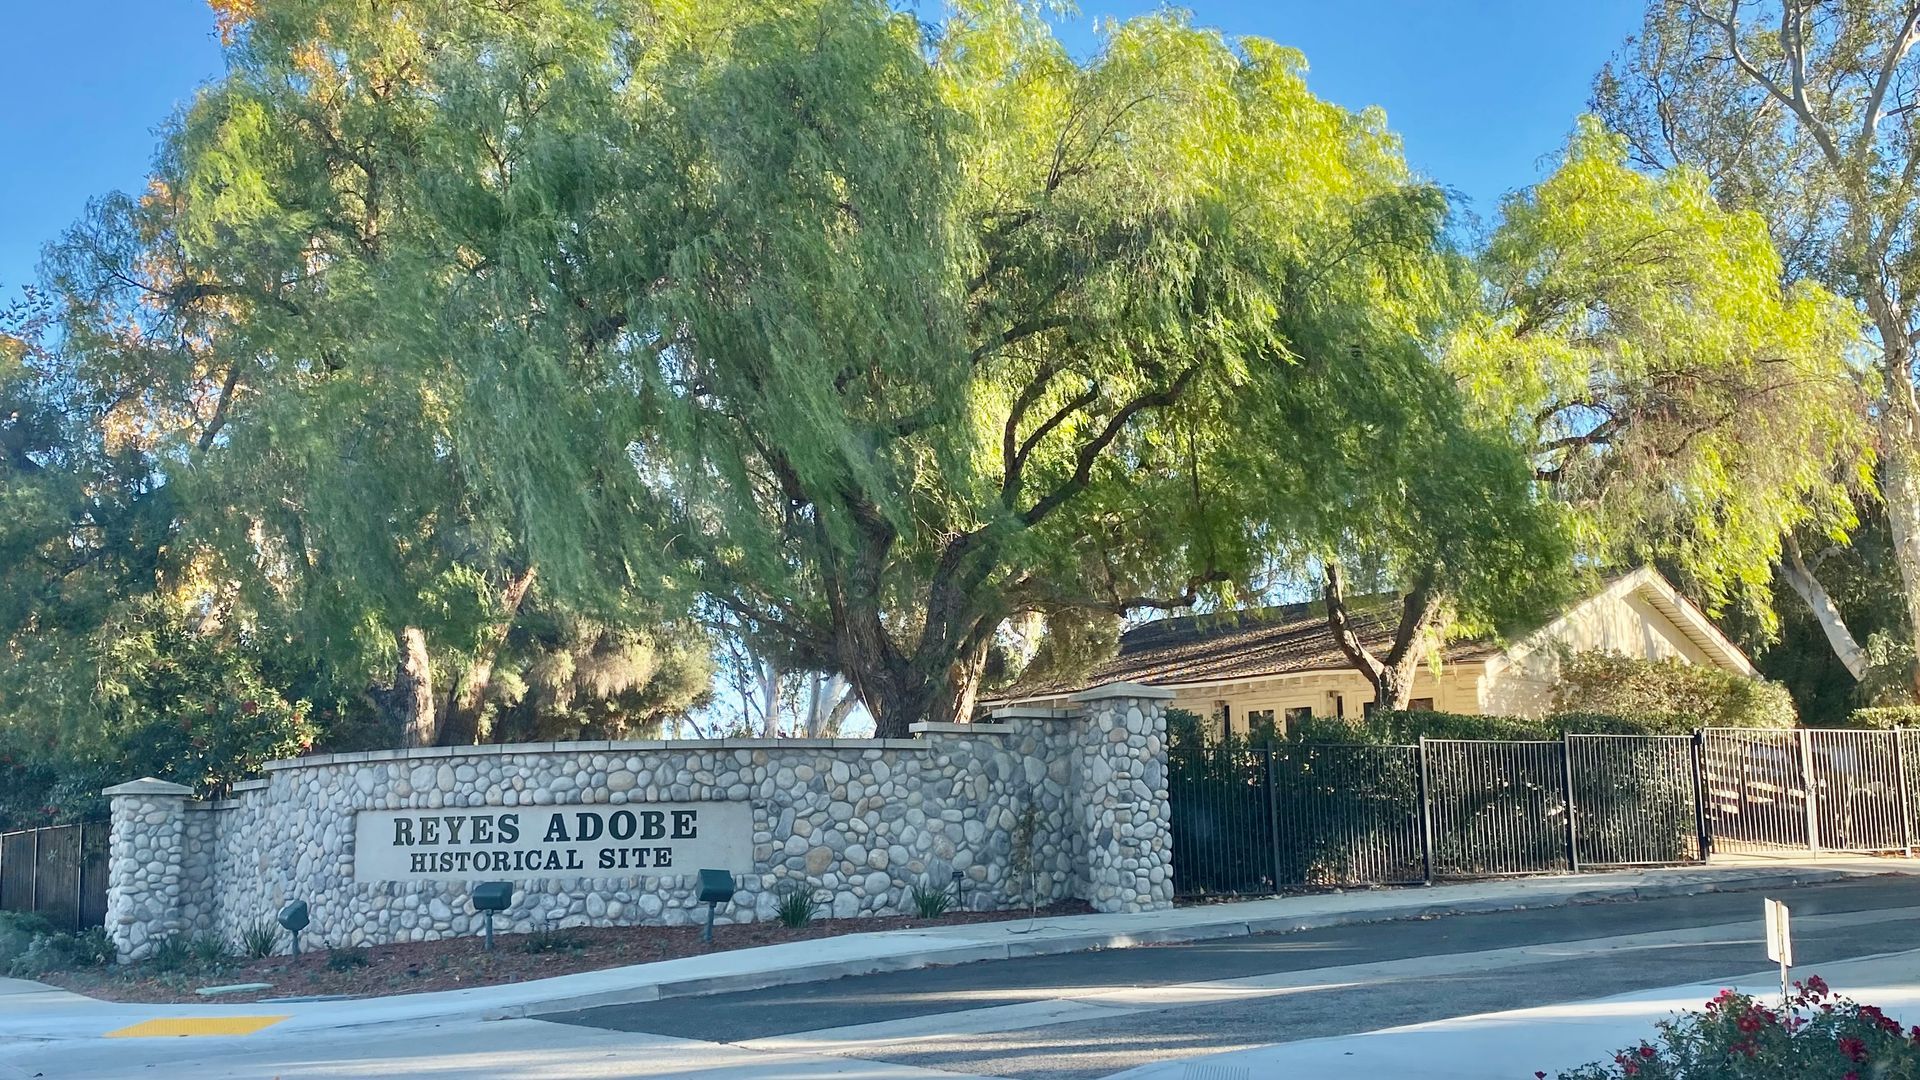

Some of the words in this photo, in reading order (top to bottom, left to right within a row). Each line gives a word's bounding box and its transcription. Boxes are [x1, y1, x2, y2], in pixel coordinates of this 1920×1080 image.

[392, 813, 520, 846] REYES
[543, 809, 698, 843] ADOBE
[409, 848, 584, 873] HISTORICAL
[598, 846, 673, 870] SITE
